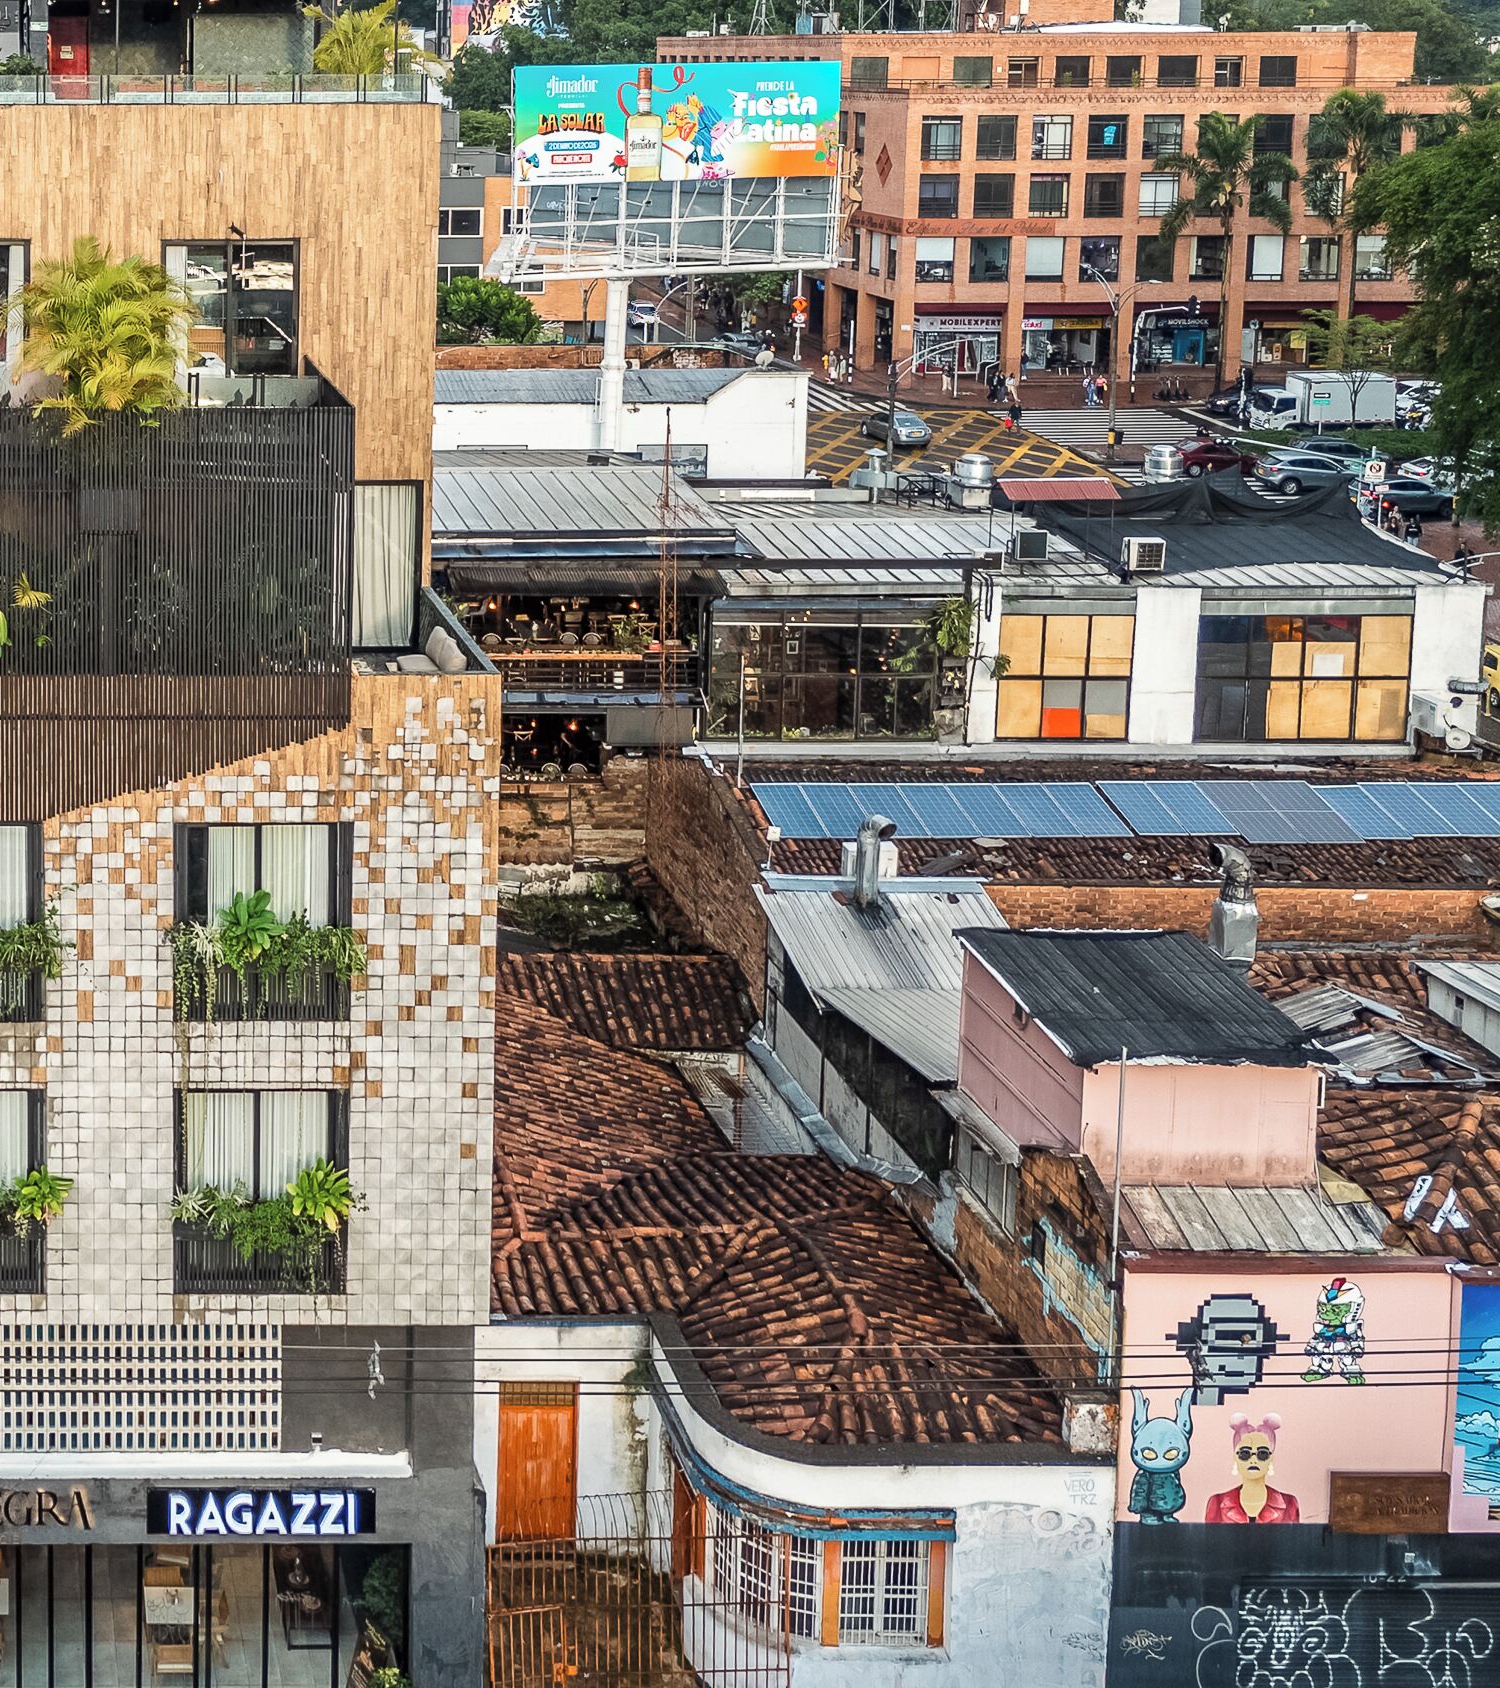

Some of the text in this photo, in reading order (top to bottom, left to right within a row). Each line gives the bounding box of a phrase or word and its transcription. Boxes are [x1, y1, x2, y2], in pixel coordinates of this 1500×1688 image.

[786, 80, 795, 91] LA
[733, 91, 818, 117] Fiesta
[538, 112, 605, 135] LA SOLAR
[734, 118, 817, 143] Latina
[1064, 1479, 1095, 1493] VERO
[1069, 1493, 1098, 1506] TRZ
[169, 1491, 359, 1536] RAGAZZI
